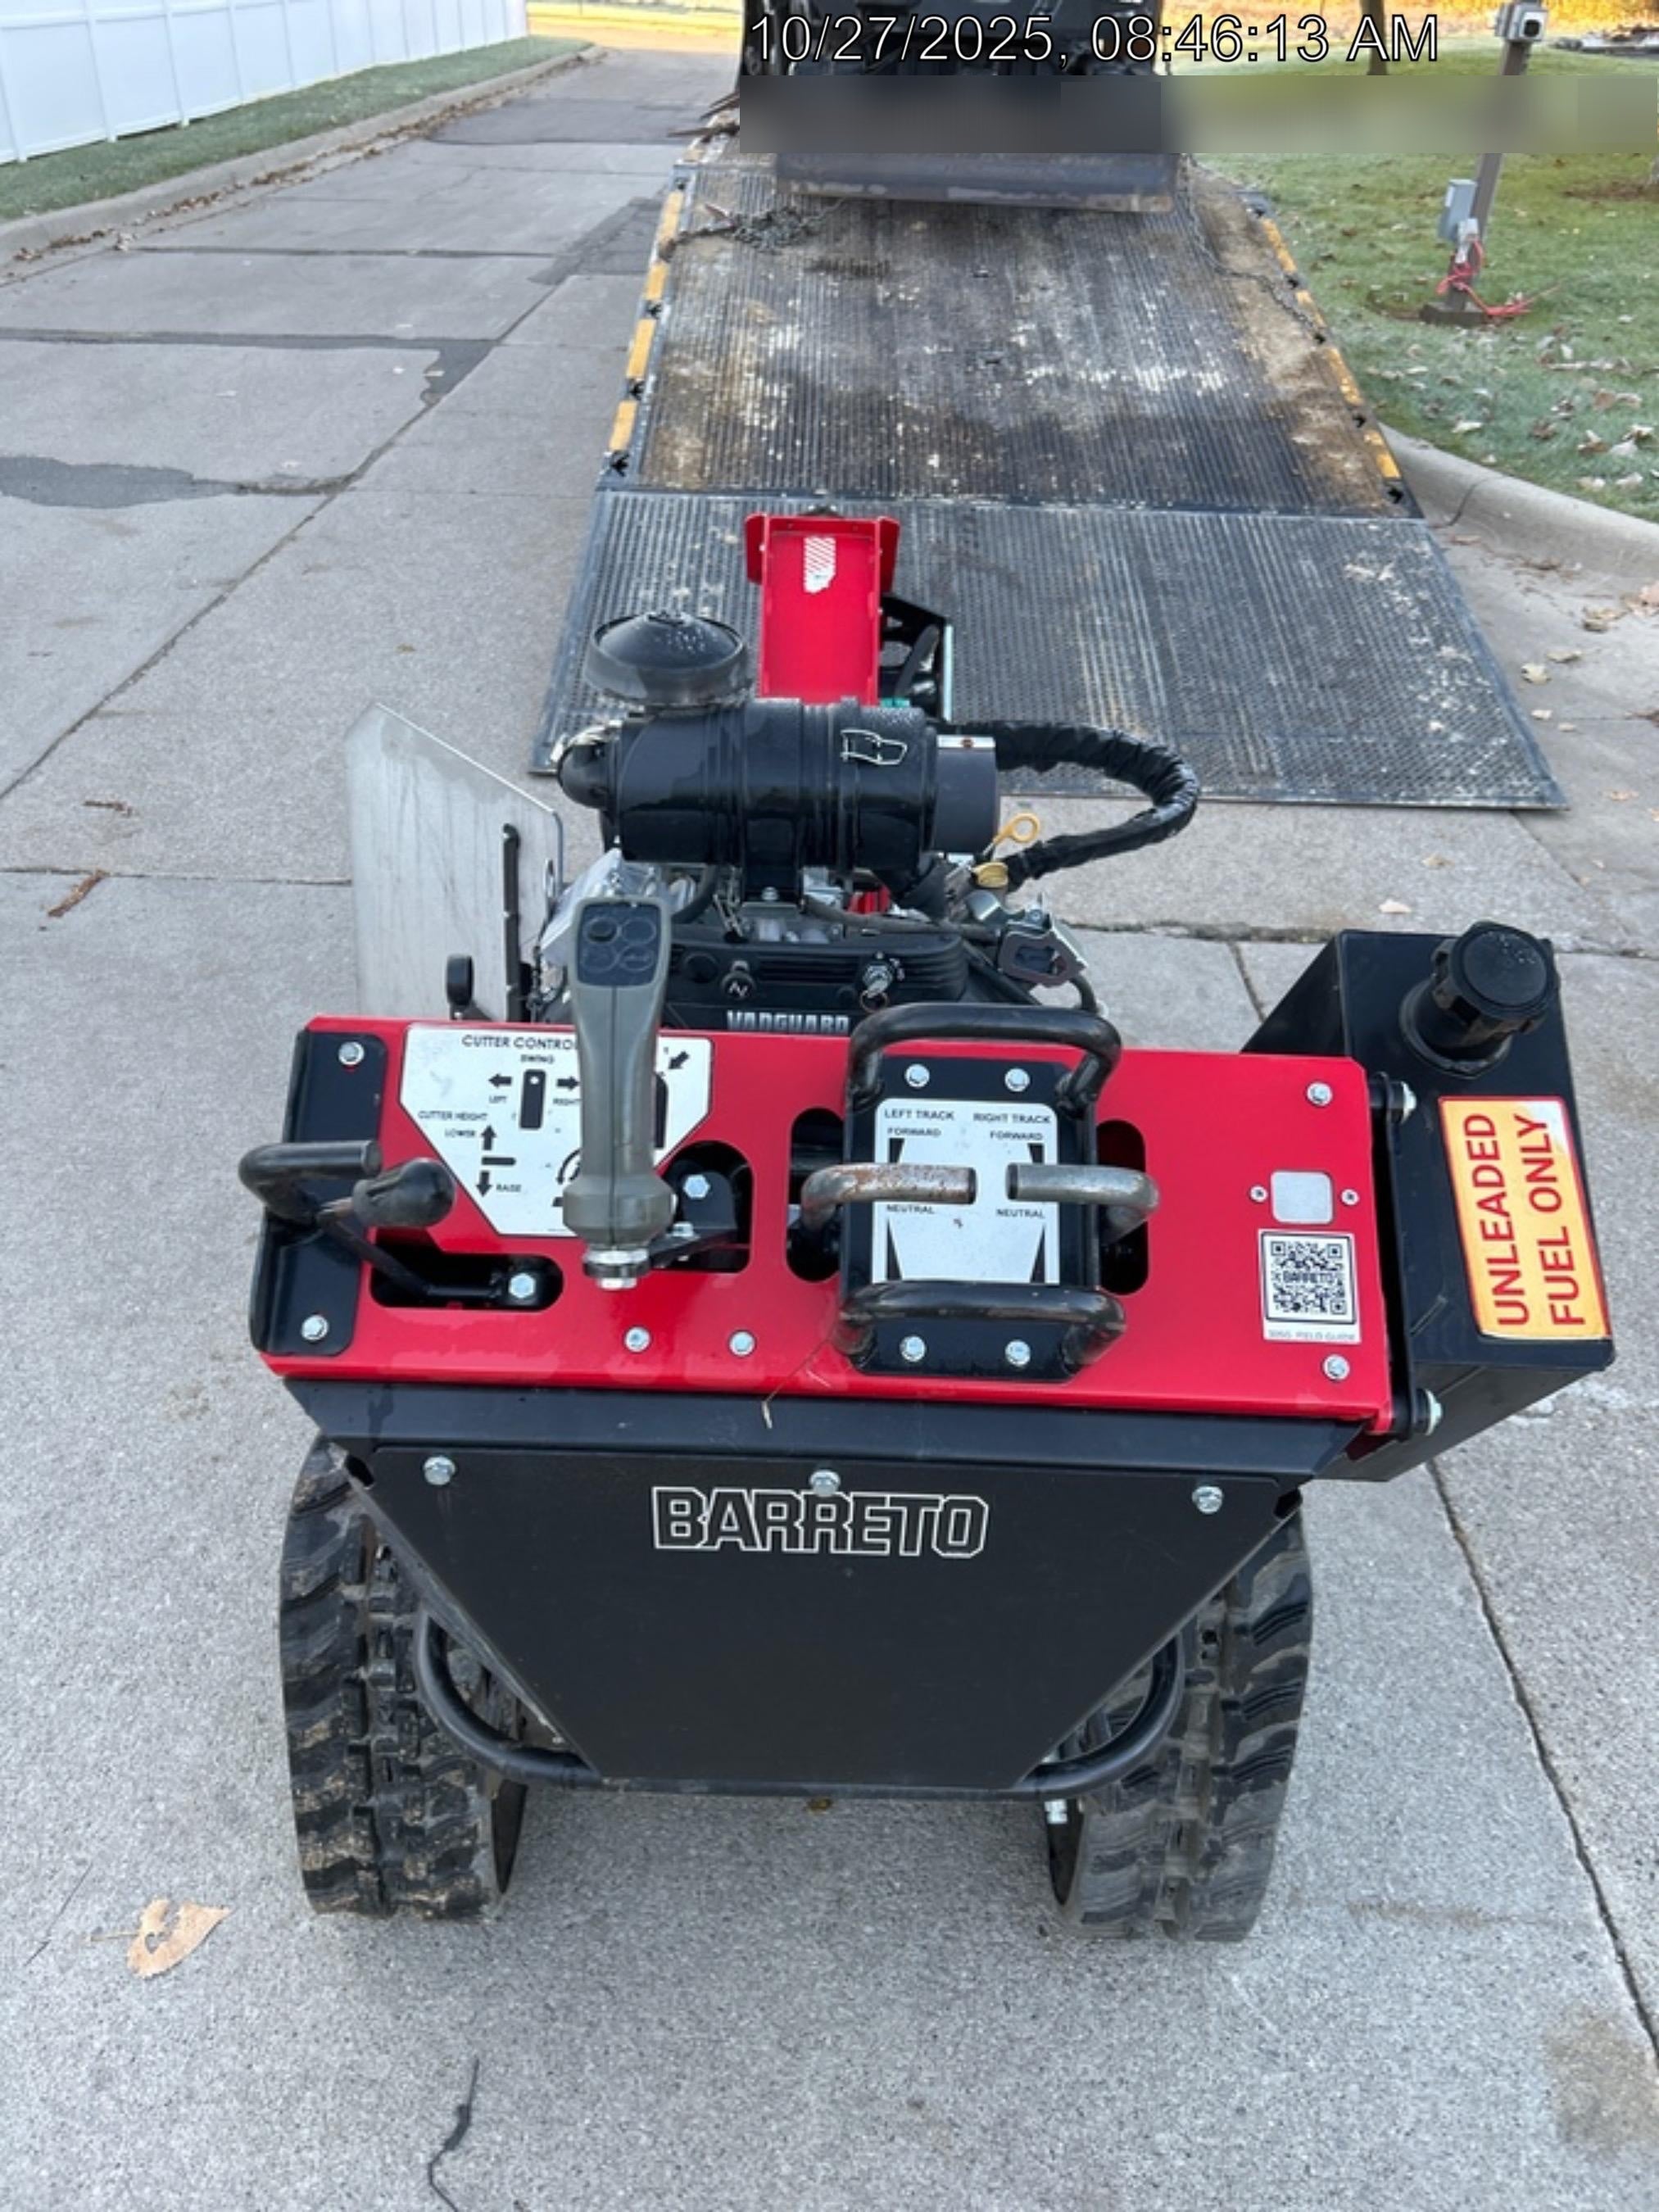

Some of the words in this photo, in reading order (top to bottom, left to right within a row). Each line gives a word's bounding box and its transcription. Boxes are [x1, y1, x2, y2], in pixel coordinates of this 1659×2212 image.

[727, 1009, 850, 1033] VANGUARD
[461, 1035, 510, 1048] CUTTER
[513, 1036, 575, 1049] CONTRO
[520, 1054, 555, 1064] SWING
[489, 1095, 507, 1104] LEFT
[418, 1110, 452, 1120] CUTTER
[456, 1112, 488, 1121] HEIGHT
[884, 1109, 912, 1120] LEFT
[916, 1110, 954, 1121] TRACK
[973, 1113, 1009, 1123] RIGHT
[1012, 1114, 1051, 1125] TRACK
[445, 1128, 476, 1138] LOWER
[887, 1127, 941, 1137] FORWARD
[990, 1131, 1044, 1141] FORWARD
[1513, 1113, 1562, 1213] ONLY
[496, 1184, 522, 1193] RAISE
[886, 1204, 936, 1215] NEUTRAL
[996, 1209, 1045, 1219] NEUTRAL
[1463, 1113, 1530, 1326] UNLEADED
[1536, 1226, 1585, 1326] FUEL
[652, 1486, 988, 1557] BARRETO
